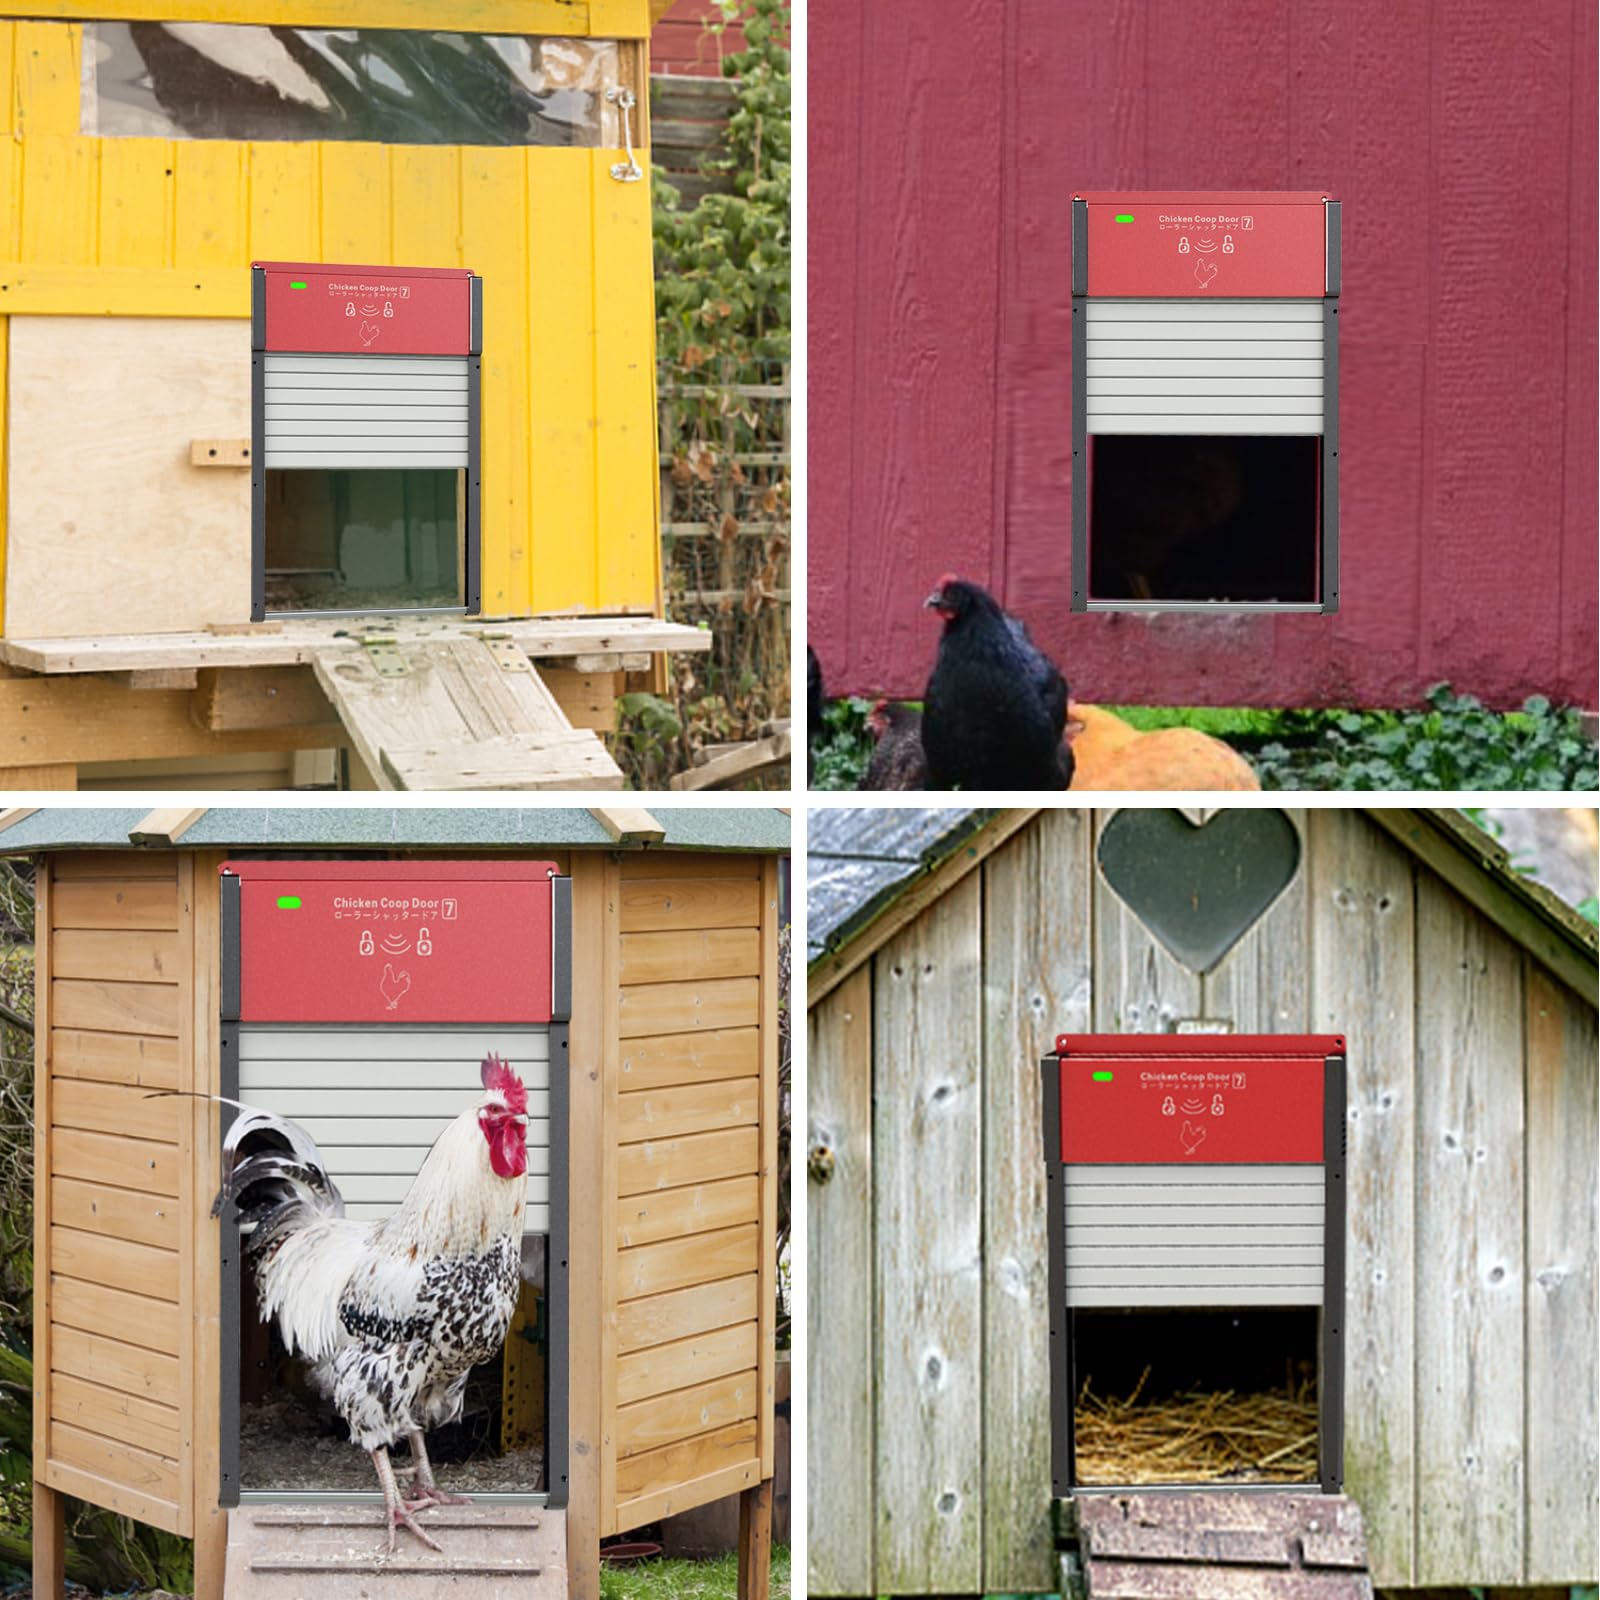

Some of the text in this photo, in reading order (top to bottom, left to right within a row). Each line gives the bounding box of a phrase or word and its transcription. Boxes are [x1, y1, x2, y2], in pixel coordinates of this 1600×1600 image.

[1159, 215, 1193, 223] Chicken
[1194, 215, 1217, 224] Coop
[359, 284, 379, 292] Coop
[333, 897, 378, 909] Chicken
[380, 897, 409, 910] Coop
[411, 897, 439, 909] Door
[334, 911, 438, 920] ローラーシャッタードア
[1140, 1072, 1178, 1081] Chicken
[1179, 1072, 1206, 1082] Coop
[1207, 1072, 1230, 1081] Door
